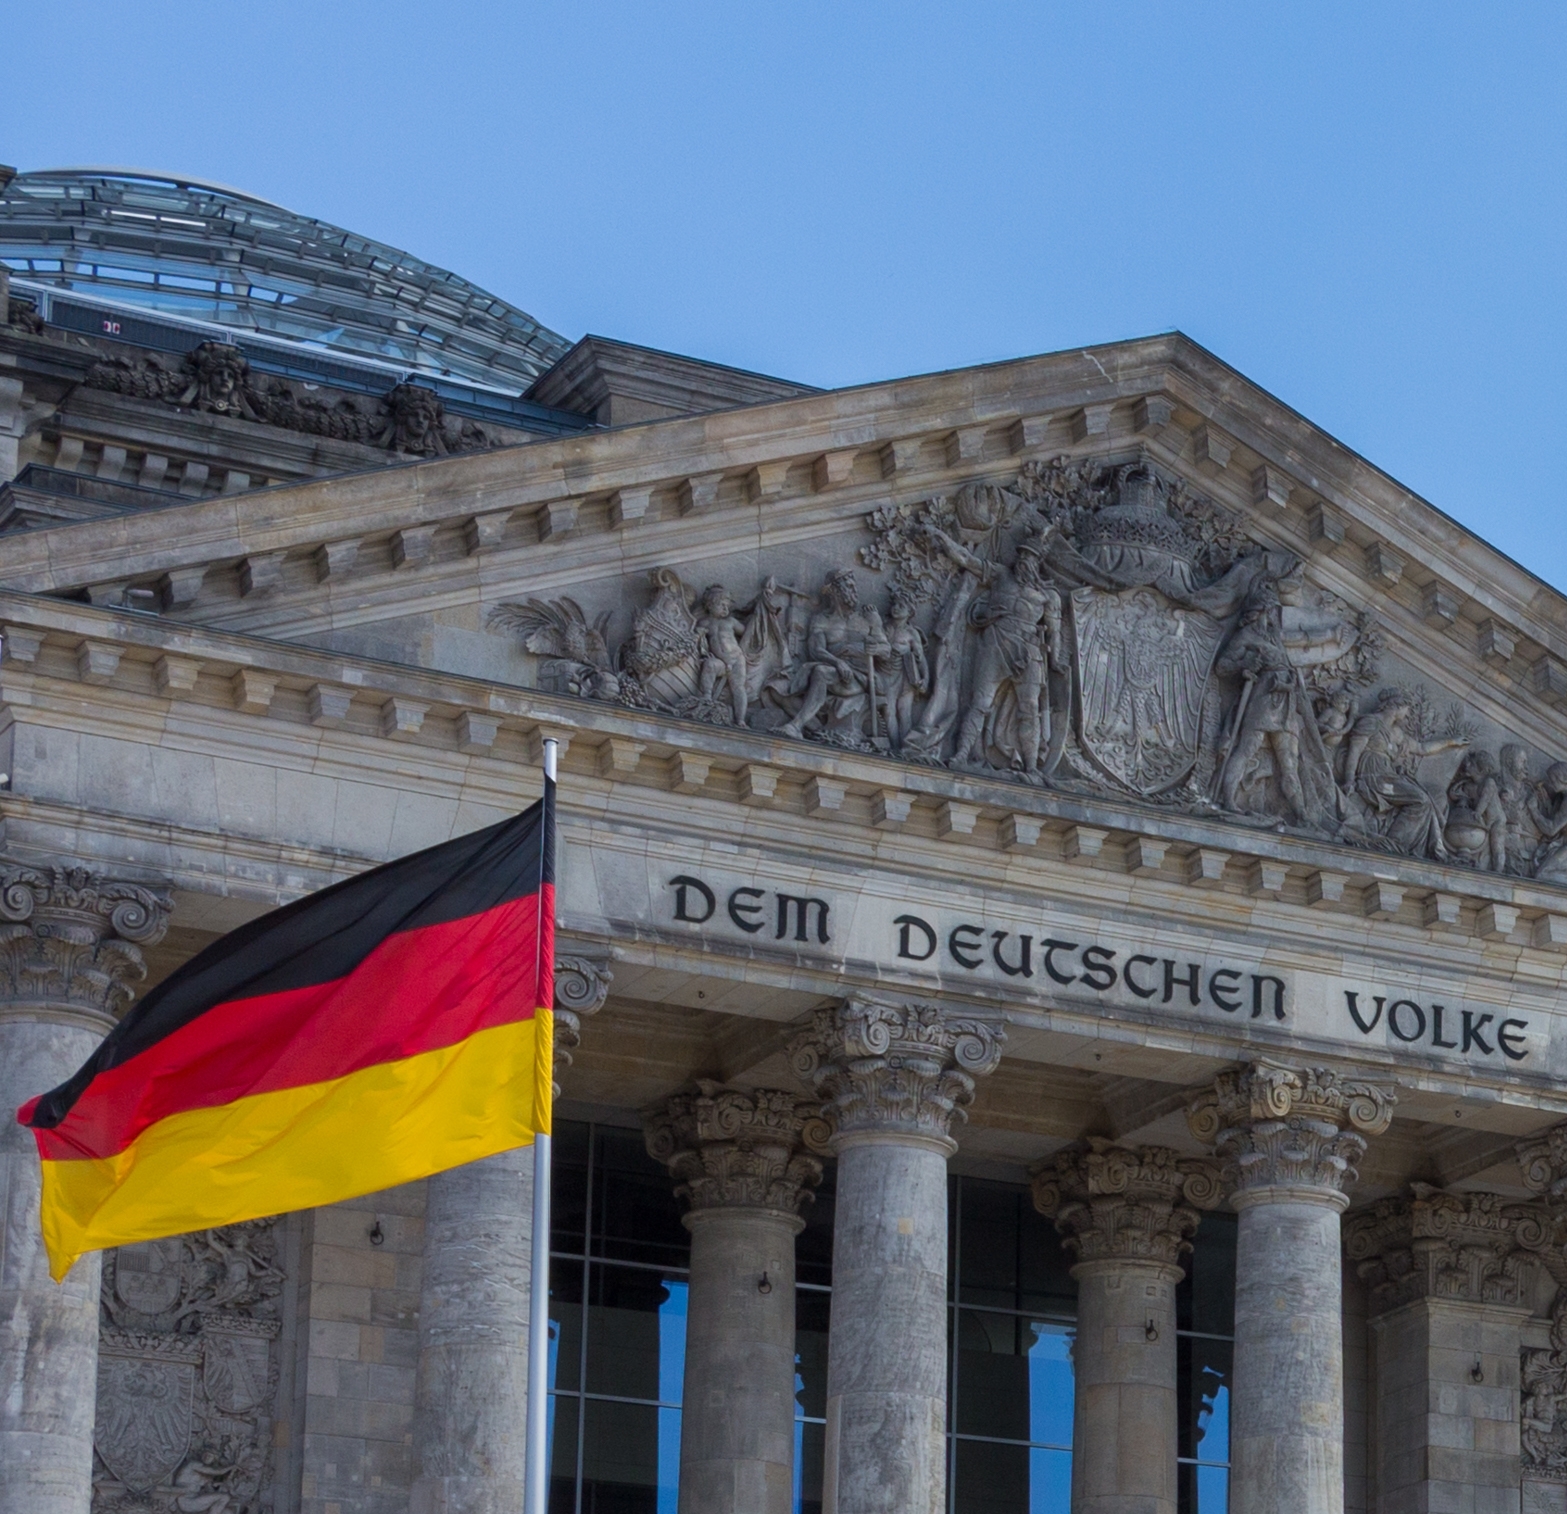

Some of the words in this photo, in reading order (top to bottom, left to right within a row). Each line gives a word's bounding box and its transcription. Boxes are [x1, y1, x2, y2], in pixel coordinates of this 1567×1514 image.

[668, 874, 831, 945] DEM
[893, 914, 1287, 1022] DEUTSCHEN
[1345, 990, 1530, 1061] VOLKE
